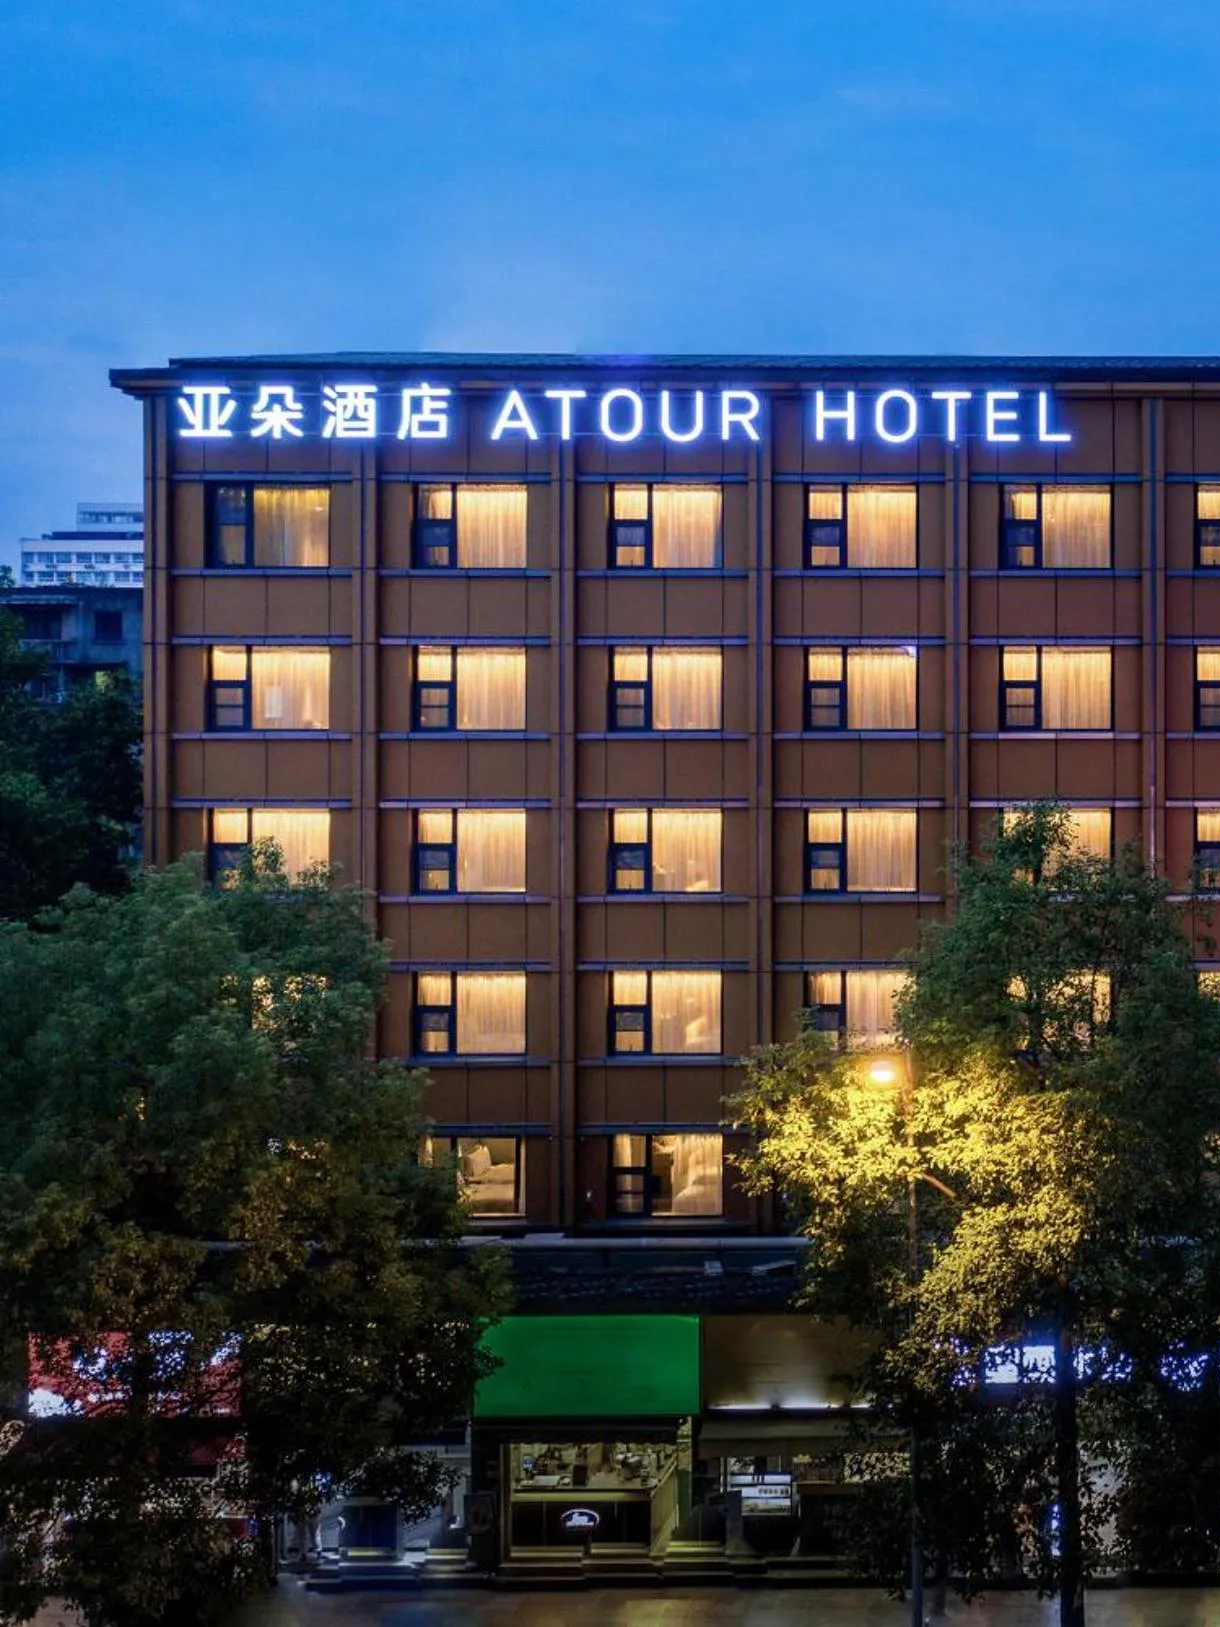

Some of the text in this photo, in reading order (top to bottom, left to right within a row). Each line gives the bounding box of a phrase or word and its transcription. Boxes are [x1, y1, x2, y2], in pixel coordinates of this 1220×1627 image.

[177, 383, 452, 439] 亚朵酒店
[489, 388, 1073, 443] ATOUR HOTEL
